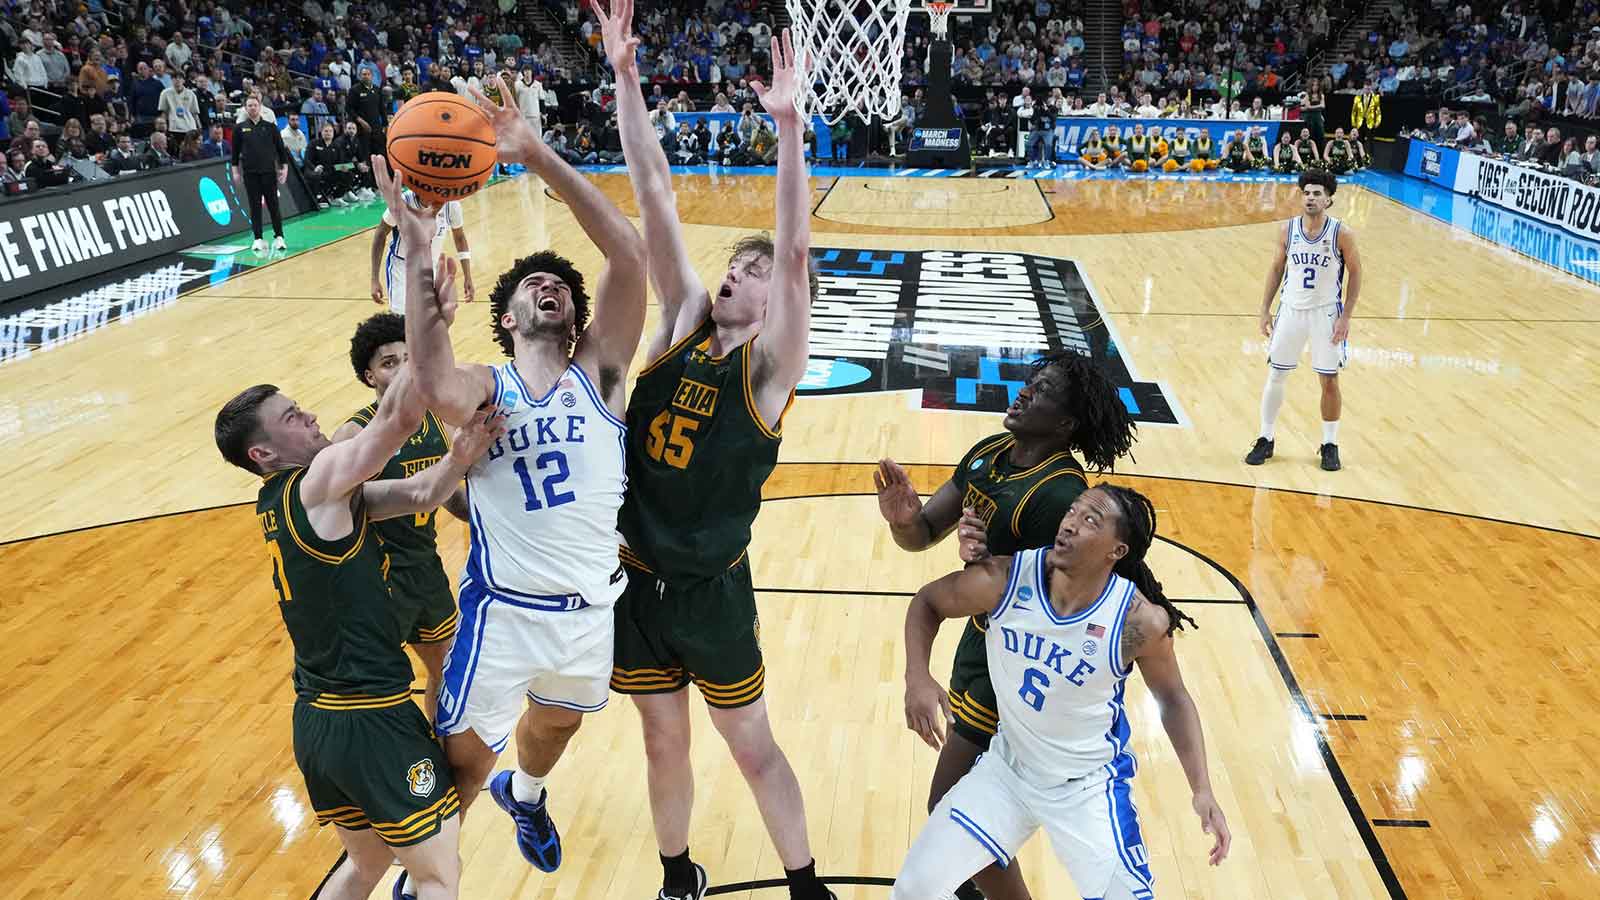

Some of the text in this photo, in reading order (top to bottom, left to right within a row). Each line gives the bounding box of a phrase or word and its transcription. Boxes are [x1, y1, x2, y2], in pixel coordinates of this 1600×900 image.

[418, 150, 472, 168] NCAA
[922, 130, 948, 138] MARCH
[923, 138, 960, 147] MADNESS
[1478, 160, 1509, 201] FIRST
[1516, 172, 1570, 219] SECOND
[20, 204, 113, 274] FINAL
[103, 189, 181, 250] FOUR
[1291, 252, 1331, 268] DUKE
[1303, 267, 1316, 289] 2
[808, 275, 904, 360] MARCH
[912, 251, 1051, 350] MADNESS
[512, 450, 577, 512] 12
[1000, 625, 1096, 688] DUKE
[1017, 667, 1050, 712] 6
